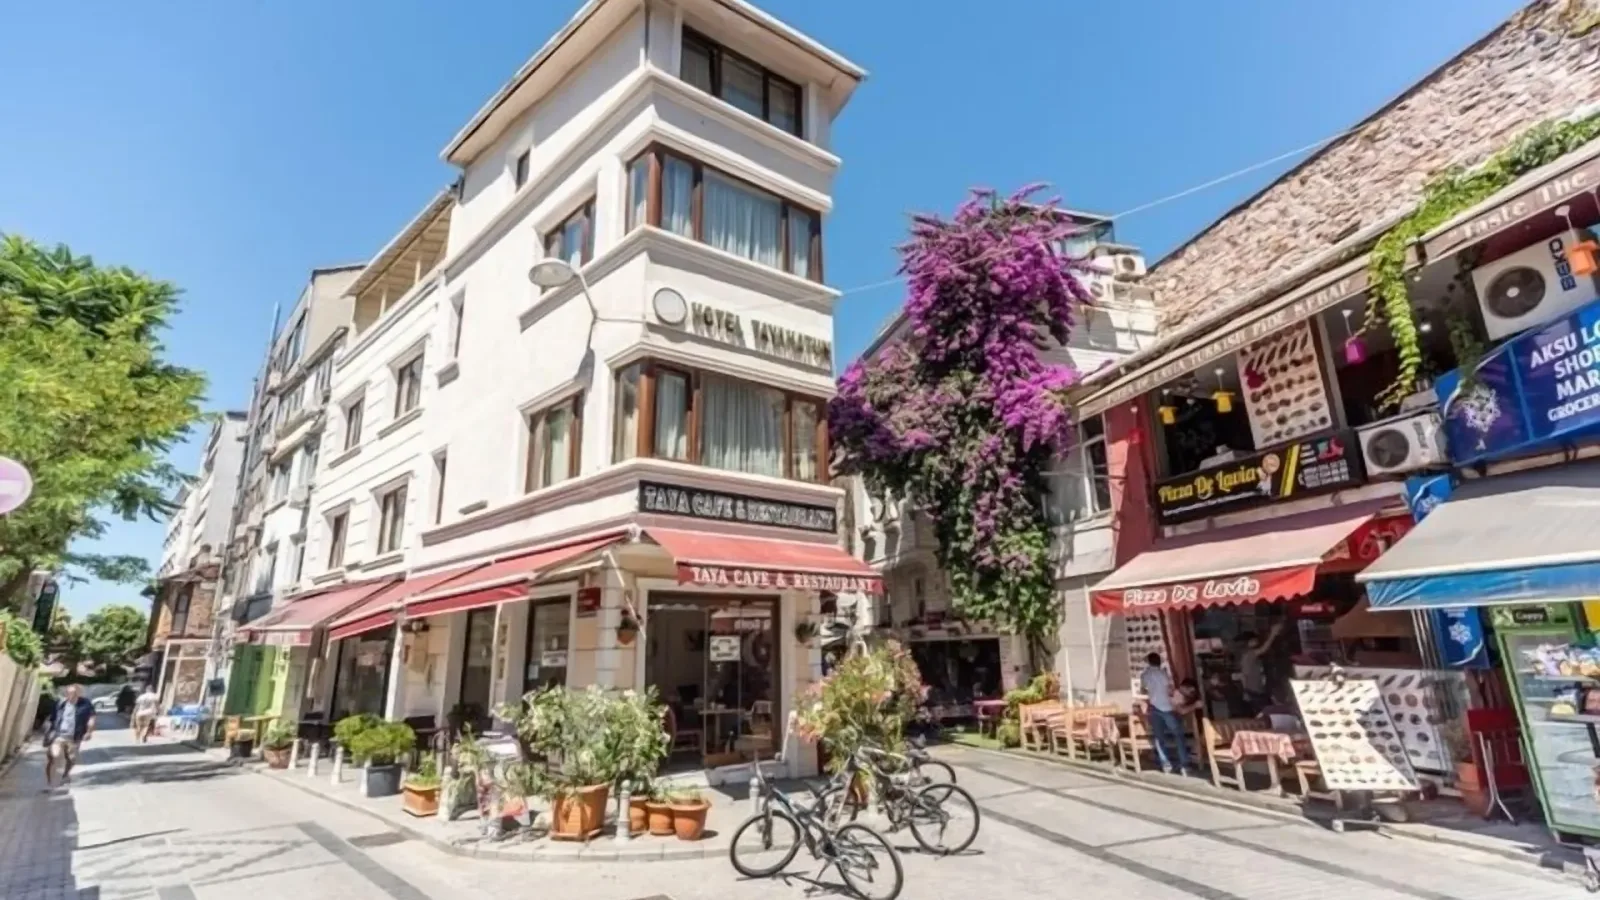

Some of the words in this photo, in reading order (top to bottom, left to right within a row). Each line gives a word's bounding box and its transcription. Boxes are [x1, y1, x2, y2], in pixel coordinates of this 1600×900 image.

[691, 301, 743, 337] HOTEL
[1530, 332, 1577, 369] AKSU
[644, 486, 691, 514] TAYA
[692, 492, 734, 519] CAFE
[735, 500, 747, 519] &
[690, 566, 729, 584] TAYA
[733, 569, 770, 586] CAFE
[776, 574, 789, 588] &
[794, 574, 874, 593] RESTAURANT
[1123, 588, 1167, 608] Pizza
[1172, 585, 1198, 604] De
[1202, 576, 1260, 600] Lavia
